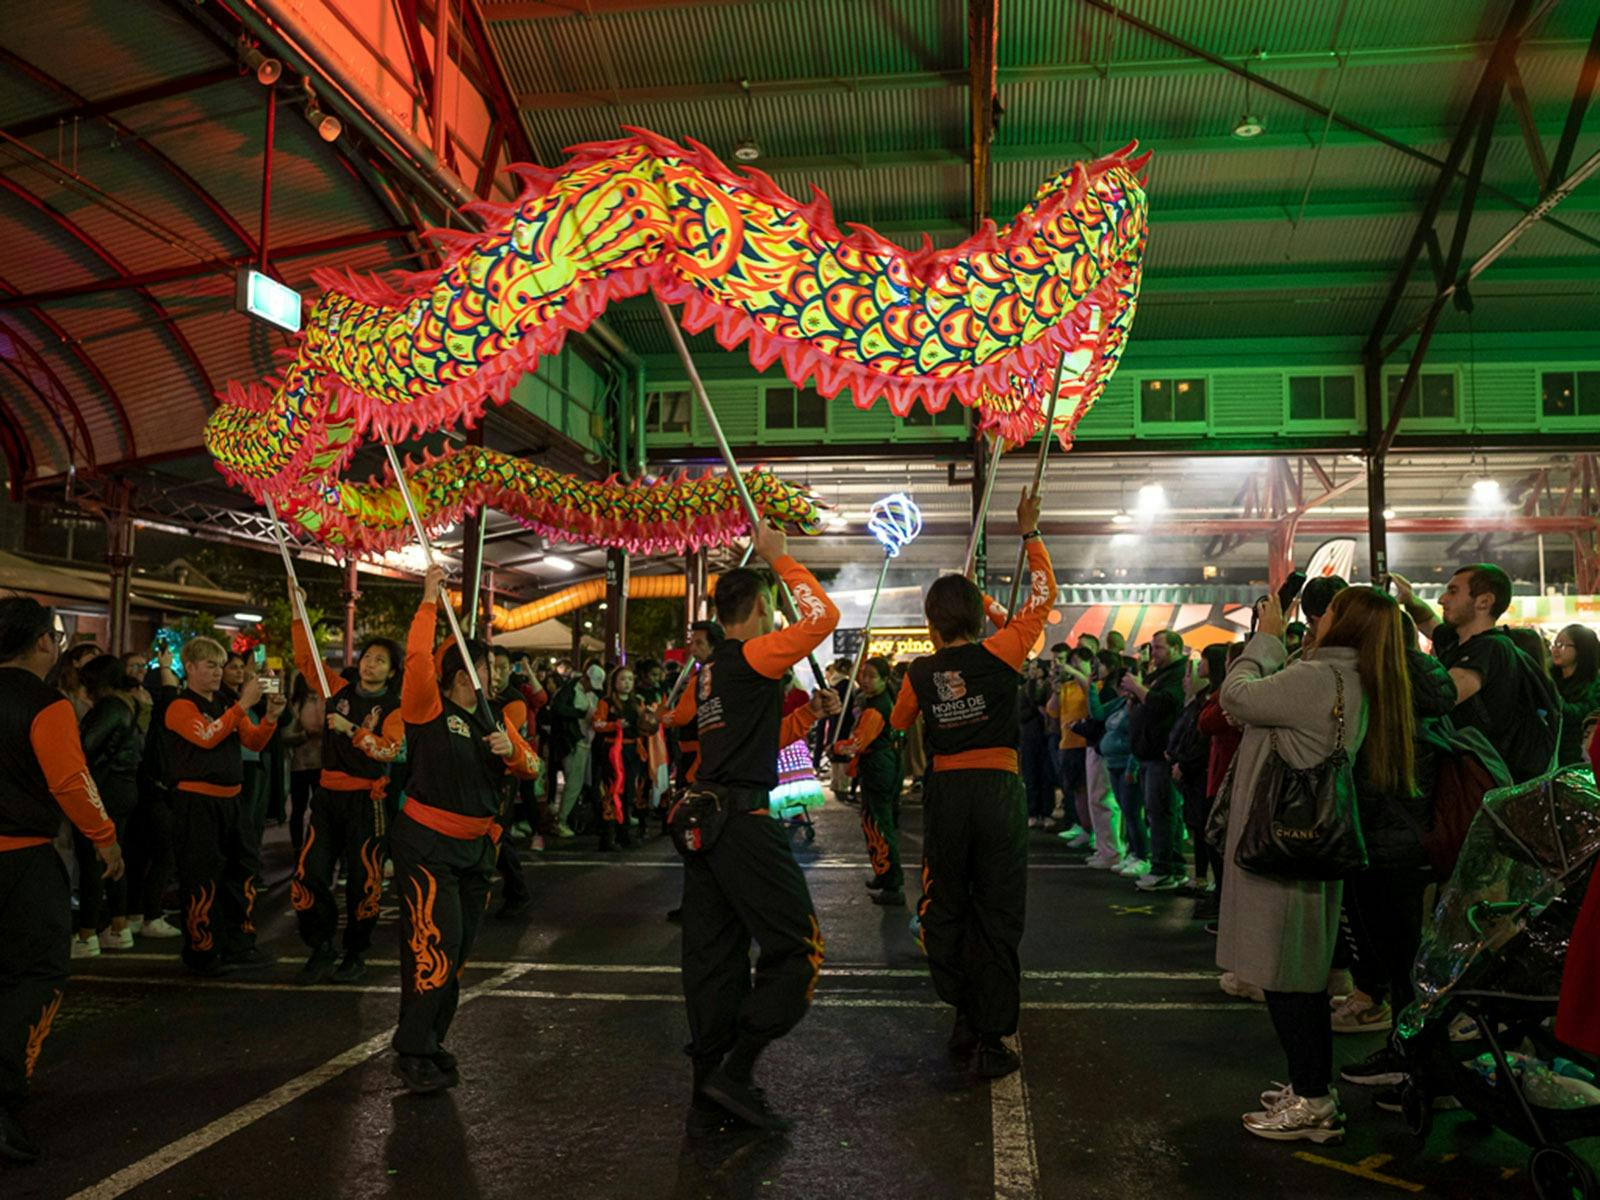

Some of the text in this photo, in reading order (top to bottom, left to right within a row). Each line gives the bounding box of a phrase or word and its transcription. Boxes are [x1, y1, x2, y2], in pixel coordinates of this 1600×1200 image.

[932, 700, 965, 714] HONG
[967, 694, 986, 708] DE
[1275, 828, 1320, 840] CHANEL
